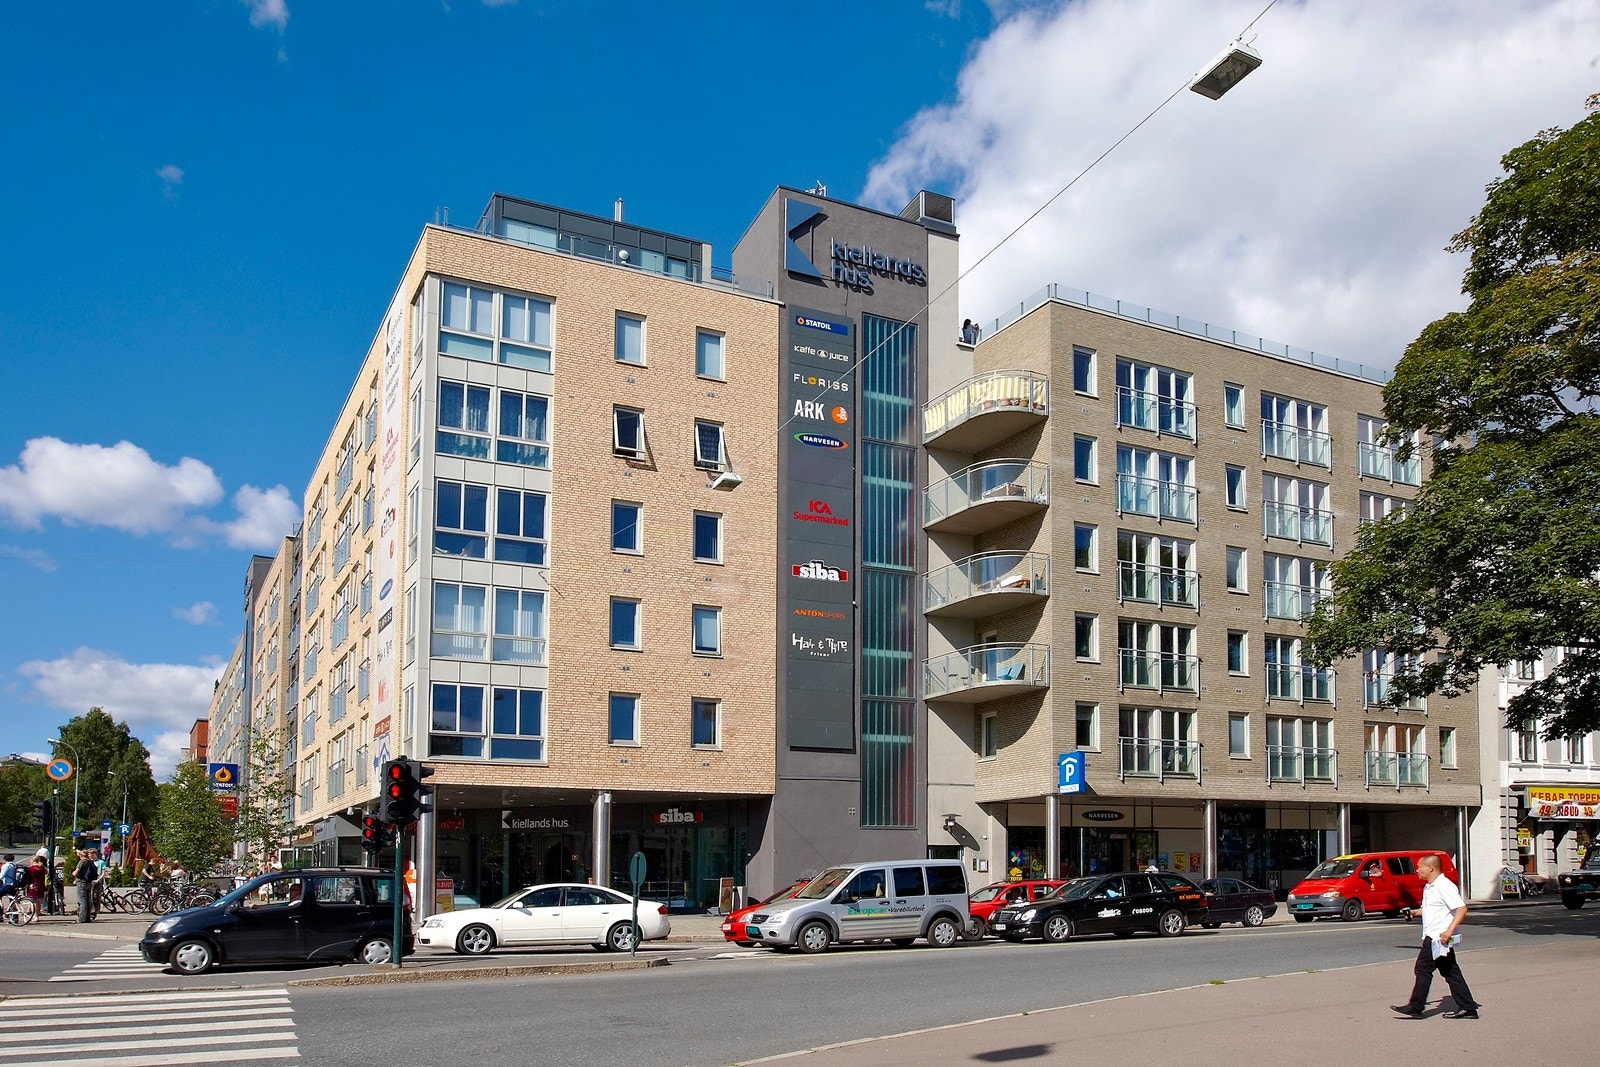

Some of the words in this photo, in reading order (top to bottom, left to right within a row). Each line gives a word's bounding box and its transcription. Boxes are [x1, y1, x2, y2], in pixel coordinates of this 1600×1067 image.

[831, 237, 926, 280] kiellands
[831, 259, 871, 287] hus
[805, 319, 832, 331] STATOIL
[794, 399, 825, 421] ARK
[803, 435, 840, 447] NARVESEN
[808, 500, 832, 515] ICA
[793, 511, 849, 527] Supermarked
[799, 562, 840, 582] siba
[792, 632, 815, 651] Hair
[1531, 793, 1565, 802] KEBAB
[660, 808, 694, 823] siba
[512, 818, 551, 829] kiellands
[552, 818, 569, 828] hus
[848, 907, 887, 916] Europcar
